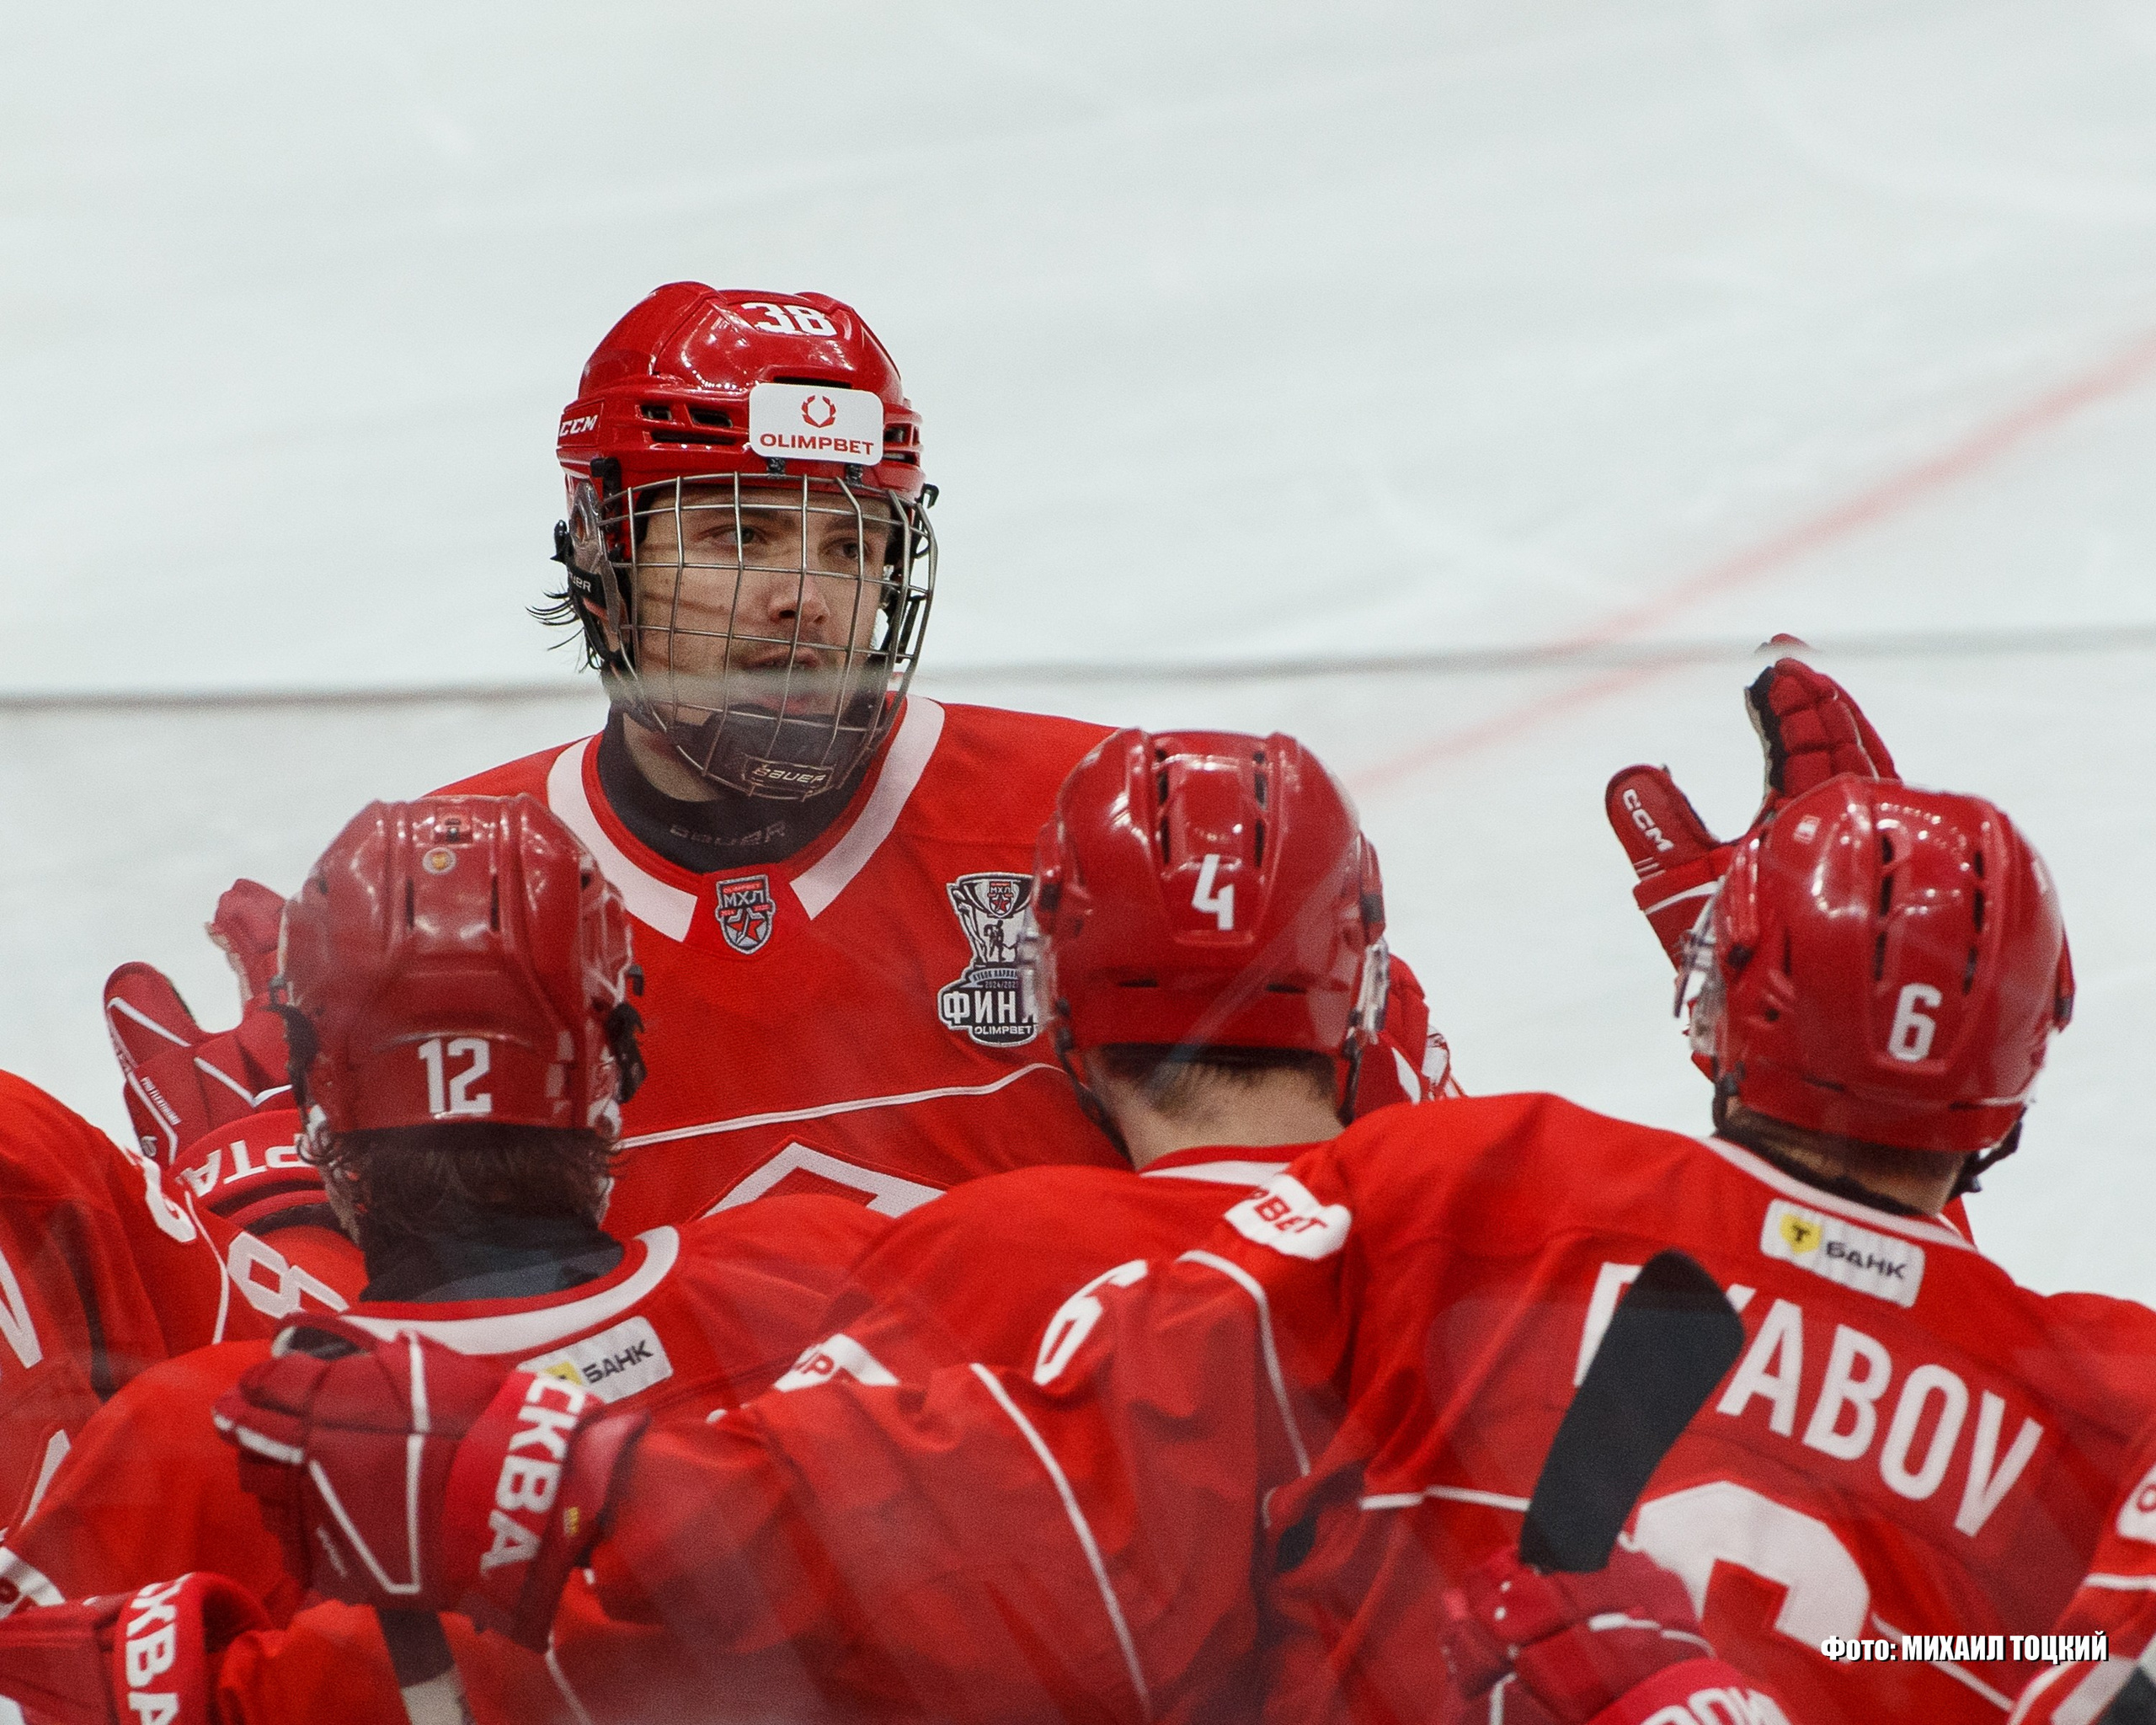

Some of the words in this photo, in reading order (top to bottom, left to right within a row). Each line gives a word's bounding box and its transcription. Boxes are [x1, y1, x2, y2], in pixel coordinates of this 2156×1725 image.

[741, 302, 837, 336] 38
[559, 414, 598, 437] CCM
[760, 433, 874, 455] OLIMPBET
[1623, 788, 1674, 852] CCM
[723, 890, 764, 908] МХЛ
[1192, 854, 1234, 931] 4
[974, 1025, 1033, 1034] OLIMPBET
[1888, 983, 1942, 1062] 6
[419, 1038, 492, 1117] 12
[176, 1134, 317, 1198] РТА
[1825, 1240, 1907, 1280] БАНК
[1033, 1258, 1149, 1386] 6
[582, 1339, 654, 1384] БАНК
[1573, 1261, 2044, 1538] ABOV
